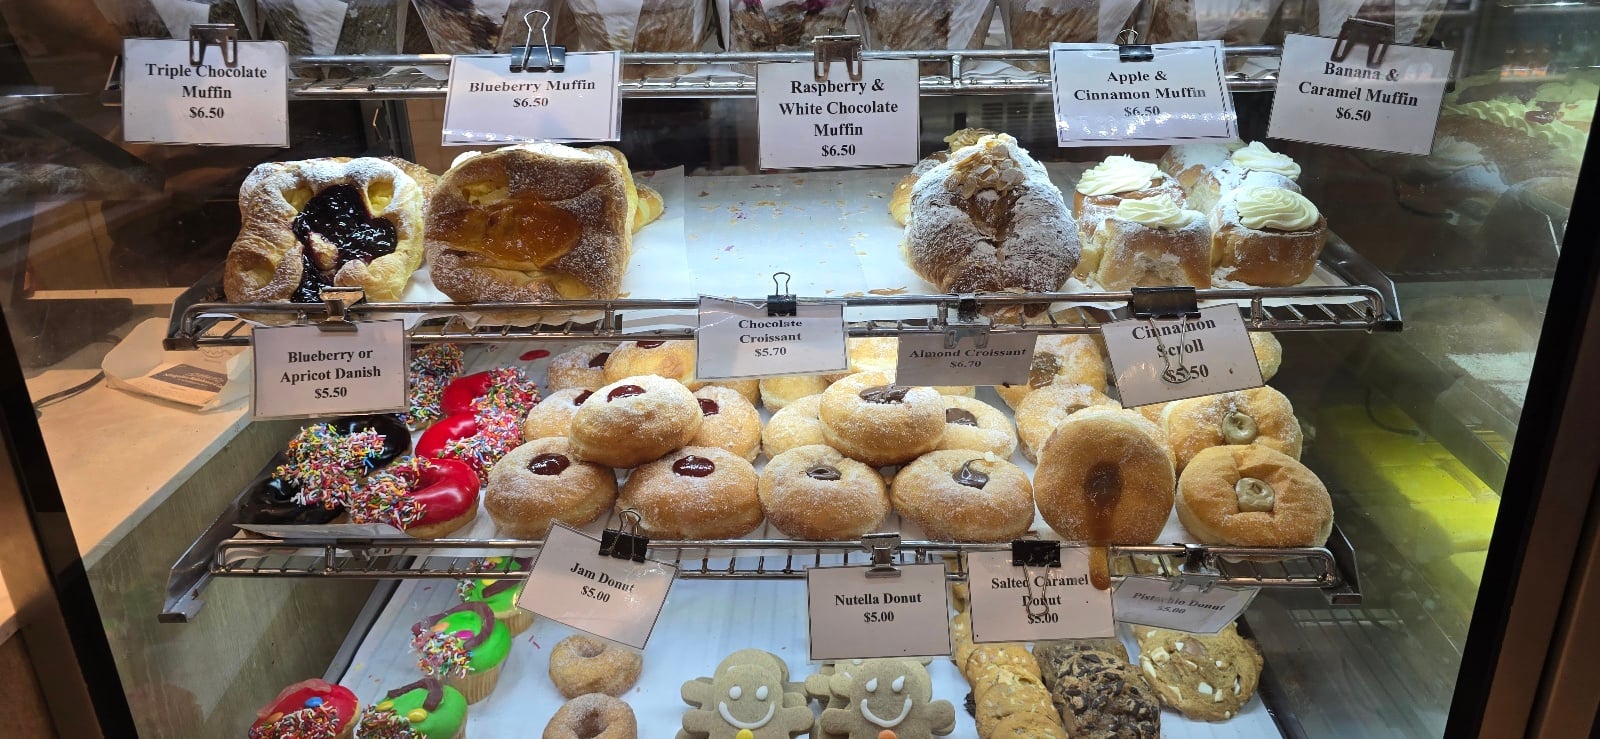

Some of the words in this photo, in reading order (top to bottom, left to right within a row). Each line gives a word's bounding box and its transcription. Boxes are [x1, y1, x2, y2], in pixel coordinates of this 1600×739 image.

[145, 63, 191, 79] Triple
[196, 65, 267, 78] Chocolate
[1107, 71, 1150, 84] Apple
[1155, 71, 1168, 81] &
[1323, 62, 1381, 80] Banana
[1386, 69, 1399, 82] &
[182, 86, 232, 98] Muffin
[469, 82, 541, 92] Blueberry
[546, 80, 596, 91] Muffin
[791, 80, 867, 96] Raspberry
[872, 79, 885, 91] &
[1074, 89, 1150, 101] Cinnamon
[1155, 87, 1207, 98] Muffin
[1298, 81, 1362, 100] Caramel
[1366, 90, 1418, 107] Muffin
[513, 98, 549, 107] $6.50
[779, 102, 823, 115] White
[827, 101, 898, 115] Chocolate
[189, 107, 224, 119] $6.50
[1124, 106, 1160, 117] $6.50
[1336, 107, 1371, 122] $6.50
[814, 123, 863, 136] Muffin
[821, 144, 855, 156] $6.50
[738, 320, 803, 329] Chocolate
[1132, 319, 1216, 340] Cinnamon
[740, 333, 802, 343] Croissant
[755, 347, 786, 357] $5.70
[909, 350, 960, 358] Almond
[964, 349, 1026, 357] Croissant
[1157, 339, 1204, 358] Scroll
[288, 351, 354, 363] Blueberry
[359, 350, 373, 359] or
[949, 360, 982, 368] $6.70
[280, 370, 331, 385] Apricot
[335, 366, 381, 379] Danish
[1165, 364, 1209, 382] $550
[315, 387, 347, 399] $5.50
[570, 563, 596, 580] Jam
[598, 572, 635, 593] Donut
[992, 578, 1030, 589] Salted
[1034, 574, 1089, 587] Caramel
[581, 585, 610, 603] $5.00
[834, 594, 879, 606] Nutella
[884, 593, 922, 604] Donut
[1022, 595, 1062, 606] Donut
[1188, 600, 1225, 610] Donut
[864, 612, 894, 622] $5.00
[1028, 613, 1058, 624] $5.00
